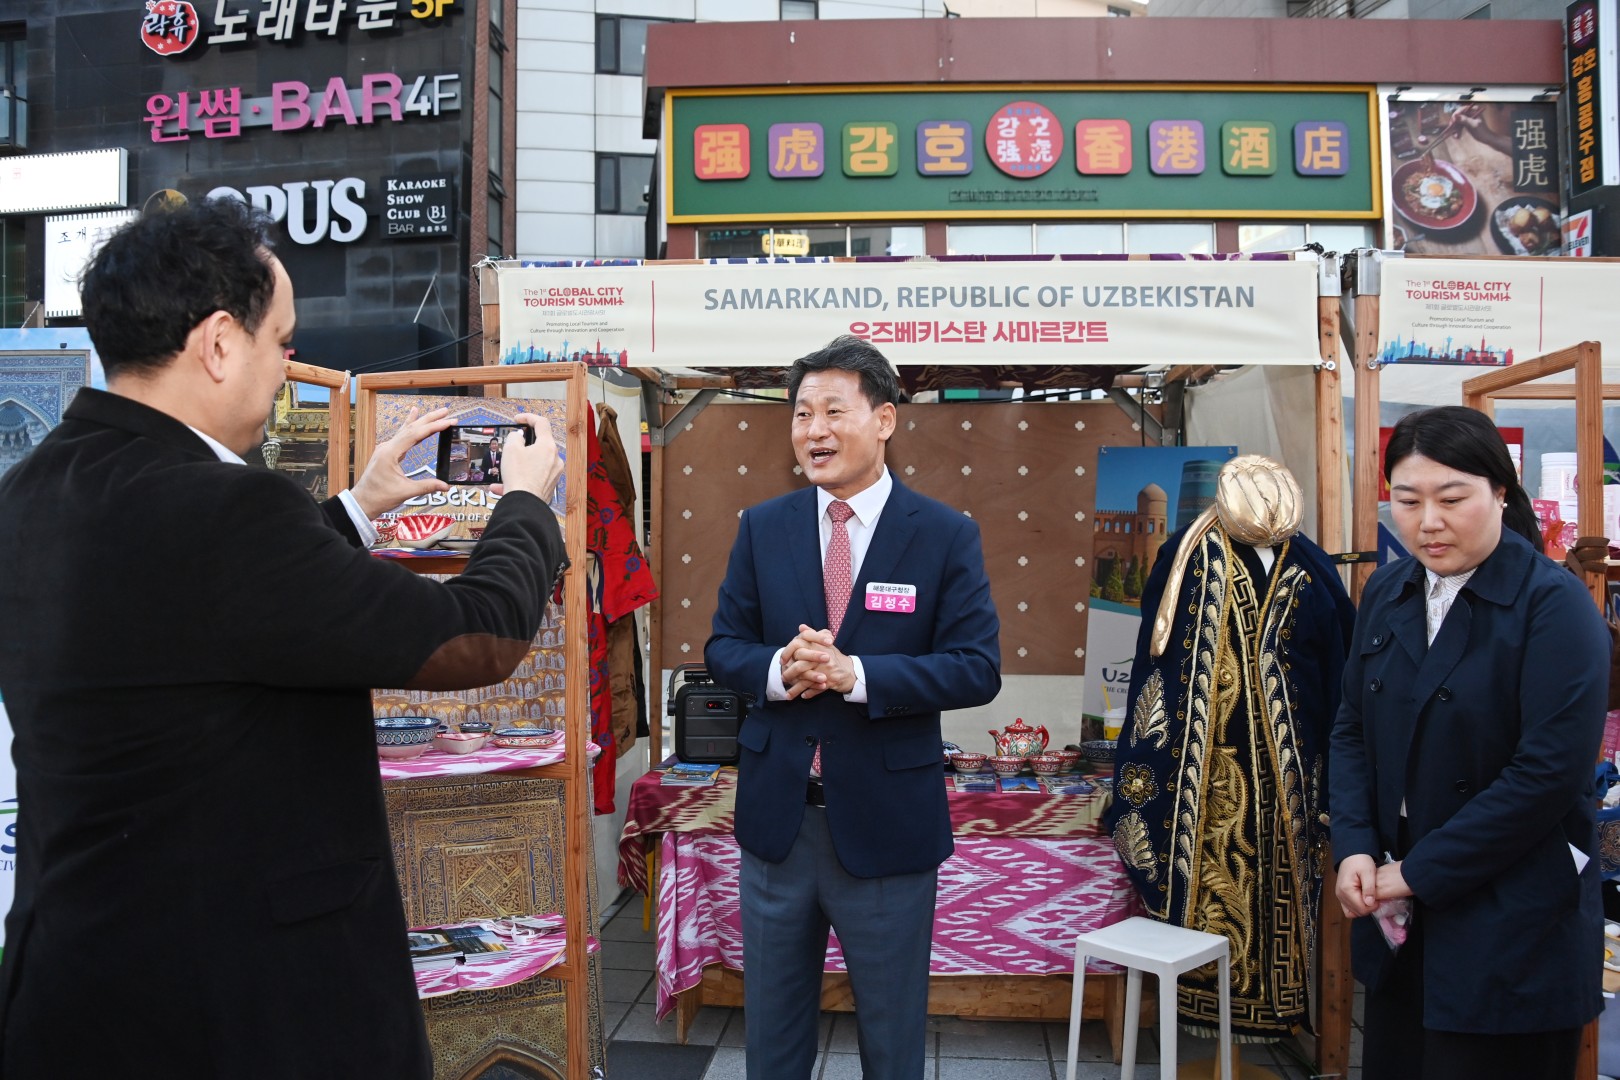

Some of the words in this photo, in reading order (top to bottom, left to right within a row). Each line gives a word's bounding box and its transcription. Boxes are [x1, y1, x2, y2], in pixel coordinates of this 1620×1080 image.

[405, 73, 459, 117] 4F
[850, 124, 968, 172] 강호
[1083, 125, 1342, 170] 香港酒店
[1515, 118, 1549, 188] 强虎
[387, 178, 447, 191] KARAOKE
[387, 194, 425, 205] SHOW
[387, 208, 421, 220] CLUB
[431, 205, 446, 219] B1
[388, 222, 414, 235] BAR
[549, 287, 595, 297] GLOBAL
[597, 287, 624, 296] CITY
[1406, 280, 1421, 288] The
[1432, 280, 1481, 290] GLOBAL
[1483, 281, 1511, 291] CITY
[704, 287, 888, 312] SAMARKAND,
[897, 286, 1030, 308] REPUBLIC
[1037, 286, 1074, 308] OF
[1083, 286, 1255, 308] UZBEKISTAN
[1406, 290, 1460, 300] TOURISM
[524, 297, 575, 307] TOURISM
[849, 321, 987, 343] 우즈베키스탄
[993, 321, 1109, 343] 사마르칸트
[468, 513, 482, 522] OF
[871, 596, 911, 610] 김성수
